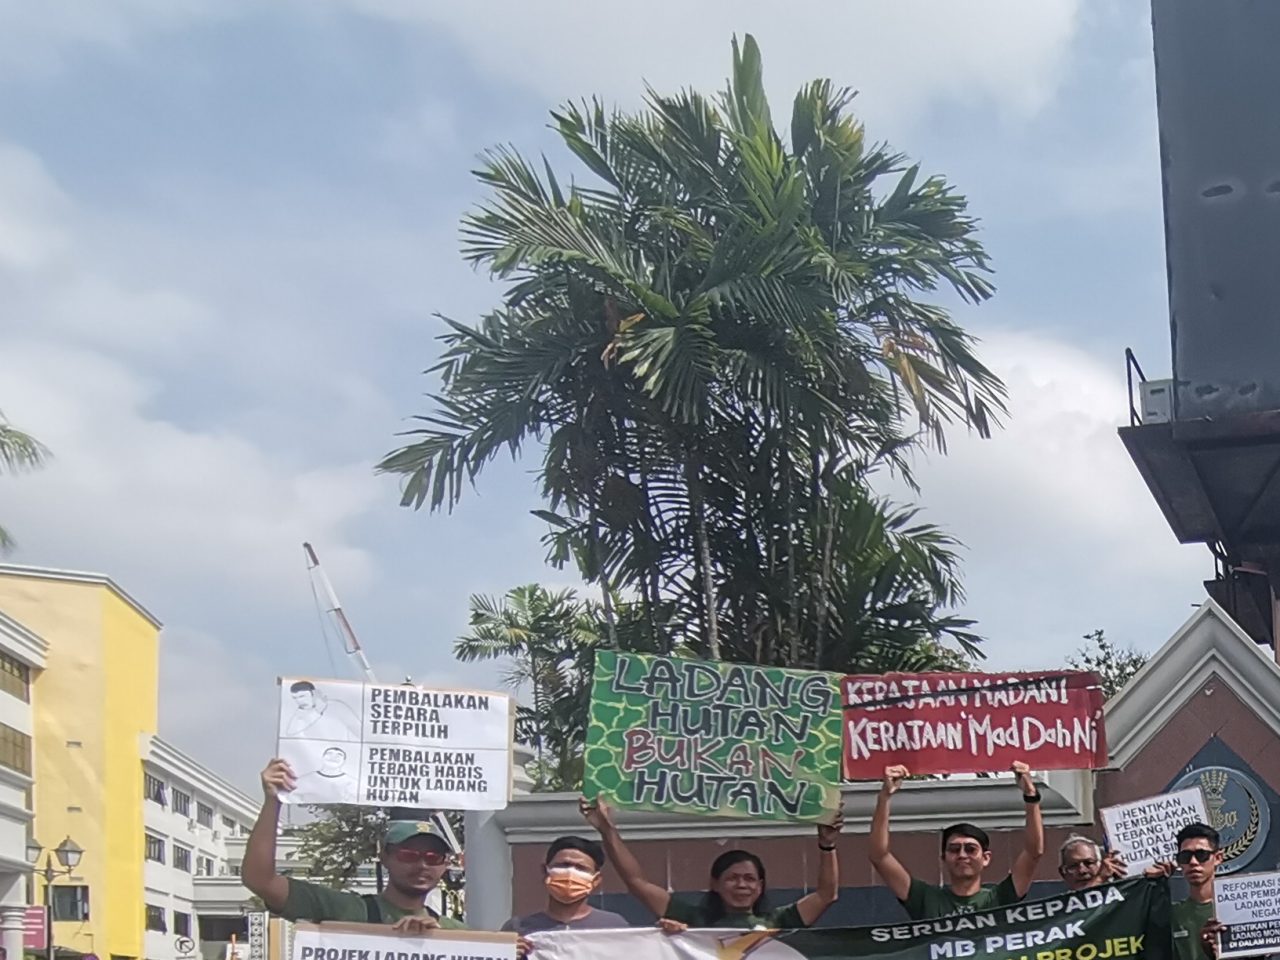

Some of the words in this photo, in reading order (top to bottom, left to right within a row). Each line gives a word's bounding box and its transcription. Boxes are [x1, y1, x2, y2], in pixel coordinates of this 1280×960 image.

[613, 657, 833, 716] LADANG
[371, 688, 489, 711] PEMBALAKAN
[371, 704, 439, 723] SECARA
[650, 700, 811, 745] HUTAN
[370, 720, 448, 739] TERPILIH
[848, 717, 962, 760] KERAJAAN
[369, 748, 475, 765] PEMBALAKAN
[623, 728, 805, 780] BUKAN
[368, 762, 429, 778] TEBANG
[434, 765, 483, 779] HABIS
[367, 776, 420, 790] UNTUK
[426, 777, 488, 792] LADANG
[634, 769, 808, 815] HUTAN
[366, 789, 419, 803] HUTAN
[1122, 798, 1181, 819] HENTIKAN
[1115, 805, 1196, 832] PEMBALAKAN
[1115, 823, 1163, 842] TEBANG
[1132, 839, 1144, 850] DI
[1147, 830, 1178, 846] DALA
[1121, 845, 1159, 863] HUTAN
[1223, 879, 1275, 892] REFORMASI
[1217, 892, 1248, 903] DASAR
[1234, 899, 1272, 911] LADANG
[870, 914, 996, 942] SERUAN
[1005, 886, 1125, 923] KEPADA
[1231, 922, 1267, 933] HENTIKAN
[929, 939, 976, 960] MB
[986, 919, 1085, 954] PERAK
